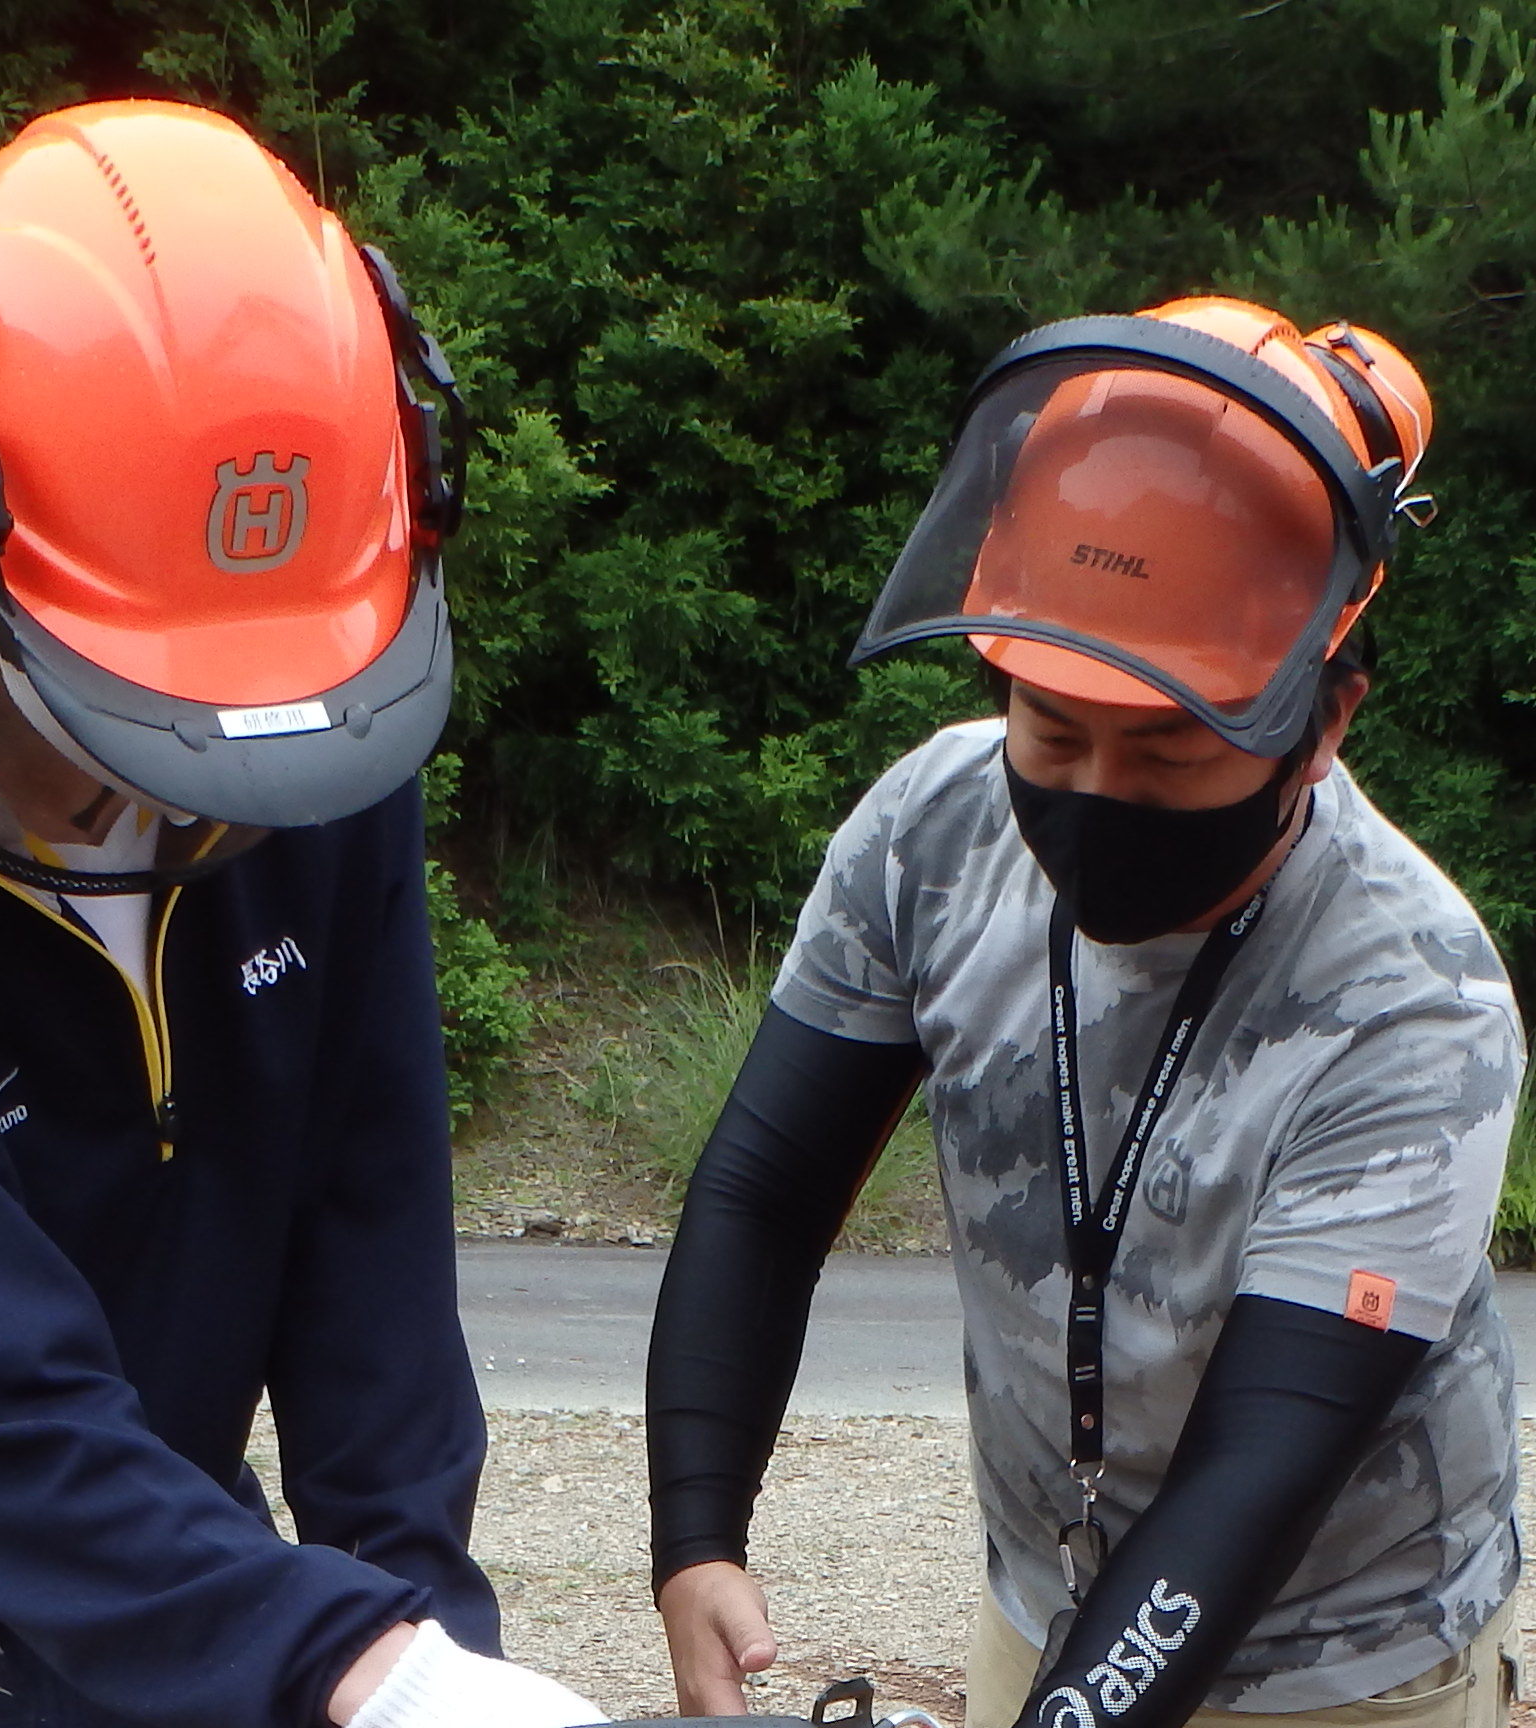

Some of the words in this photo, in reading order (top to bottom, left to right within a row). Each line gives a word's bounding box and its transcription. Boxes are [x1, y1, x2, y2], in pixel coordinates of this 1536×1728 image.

[1069, 543, 1151, 580] STIHL
[1054, 985, 1065, 1033] Great
[1057, 1037, 1070, 1088] hopes
[1060, 1091, 1075, 1136] make
[1102, 1188, 1125, 1232] Great
[1116, 1141, 1140, 1189] hopes
[1135, 1097, 1157, 1141] make
[1171, 1016, 1193, 1053] men.
[1064, 1139, 1080, 1183] great
[1069, 1184, 1083, 1226] men.
[1085, 1576, 1202, 1717] asics
